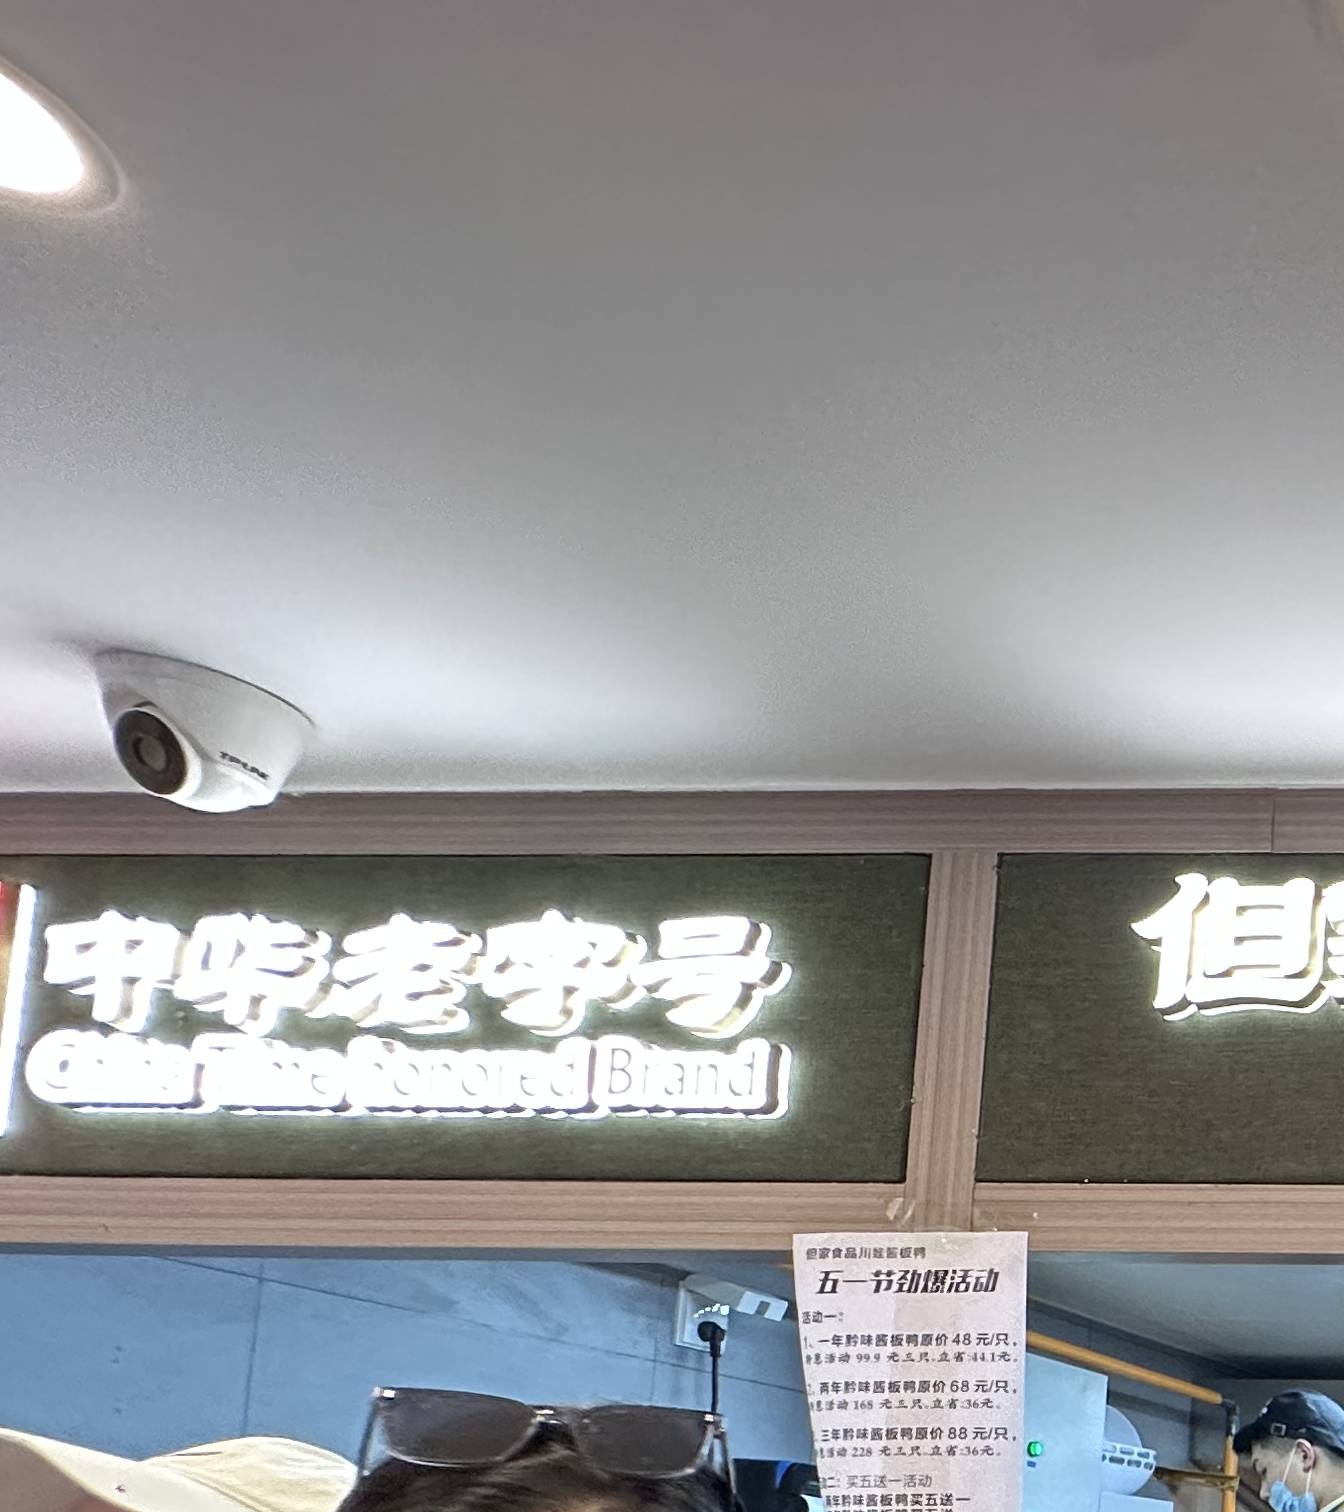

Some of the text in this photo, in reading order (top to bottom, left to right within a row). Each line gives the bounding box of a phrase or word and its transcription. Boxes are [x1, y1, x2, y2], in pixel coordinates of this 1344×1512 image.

[45, 909, 788, 1034] 中华老字号
[606, 1043, 758, 1098] Brand
[816, 1268, 1000, 1294] 五一节劲爆活动
